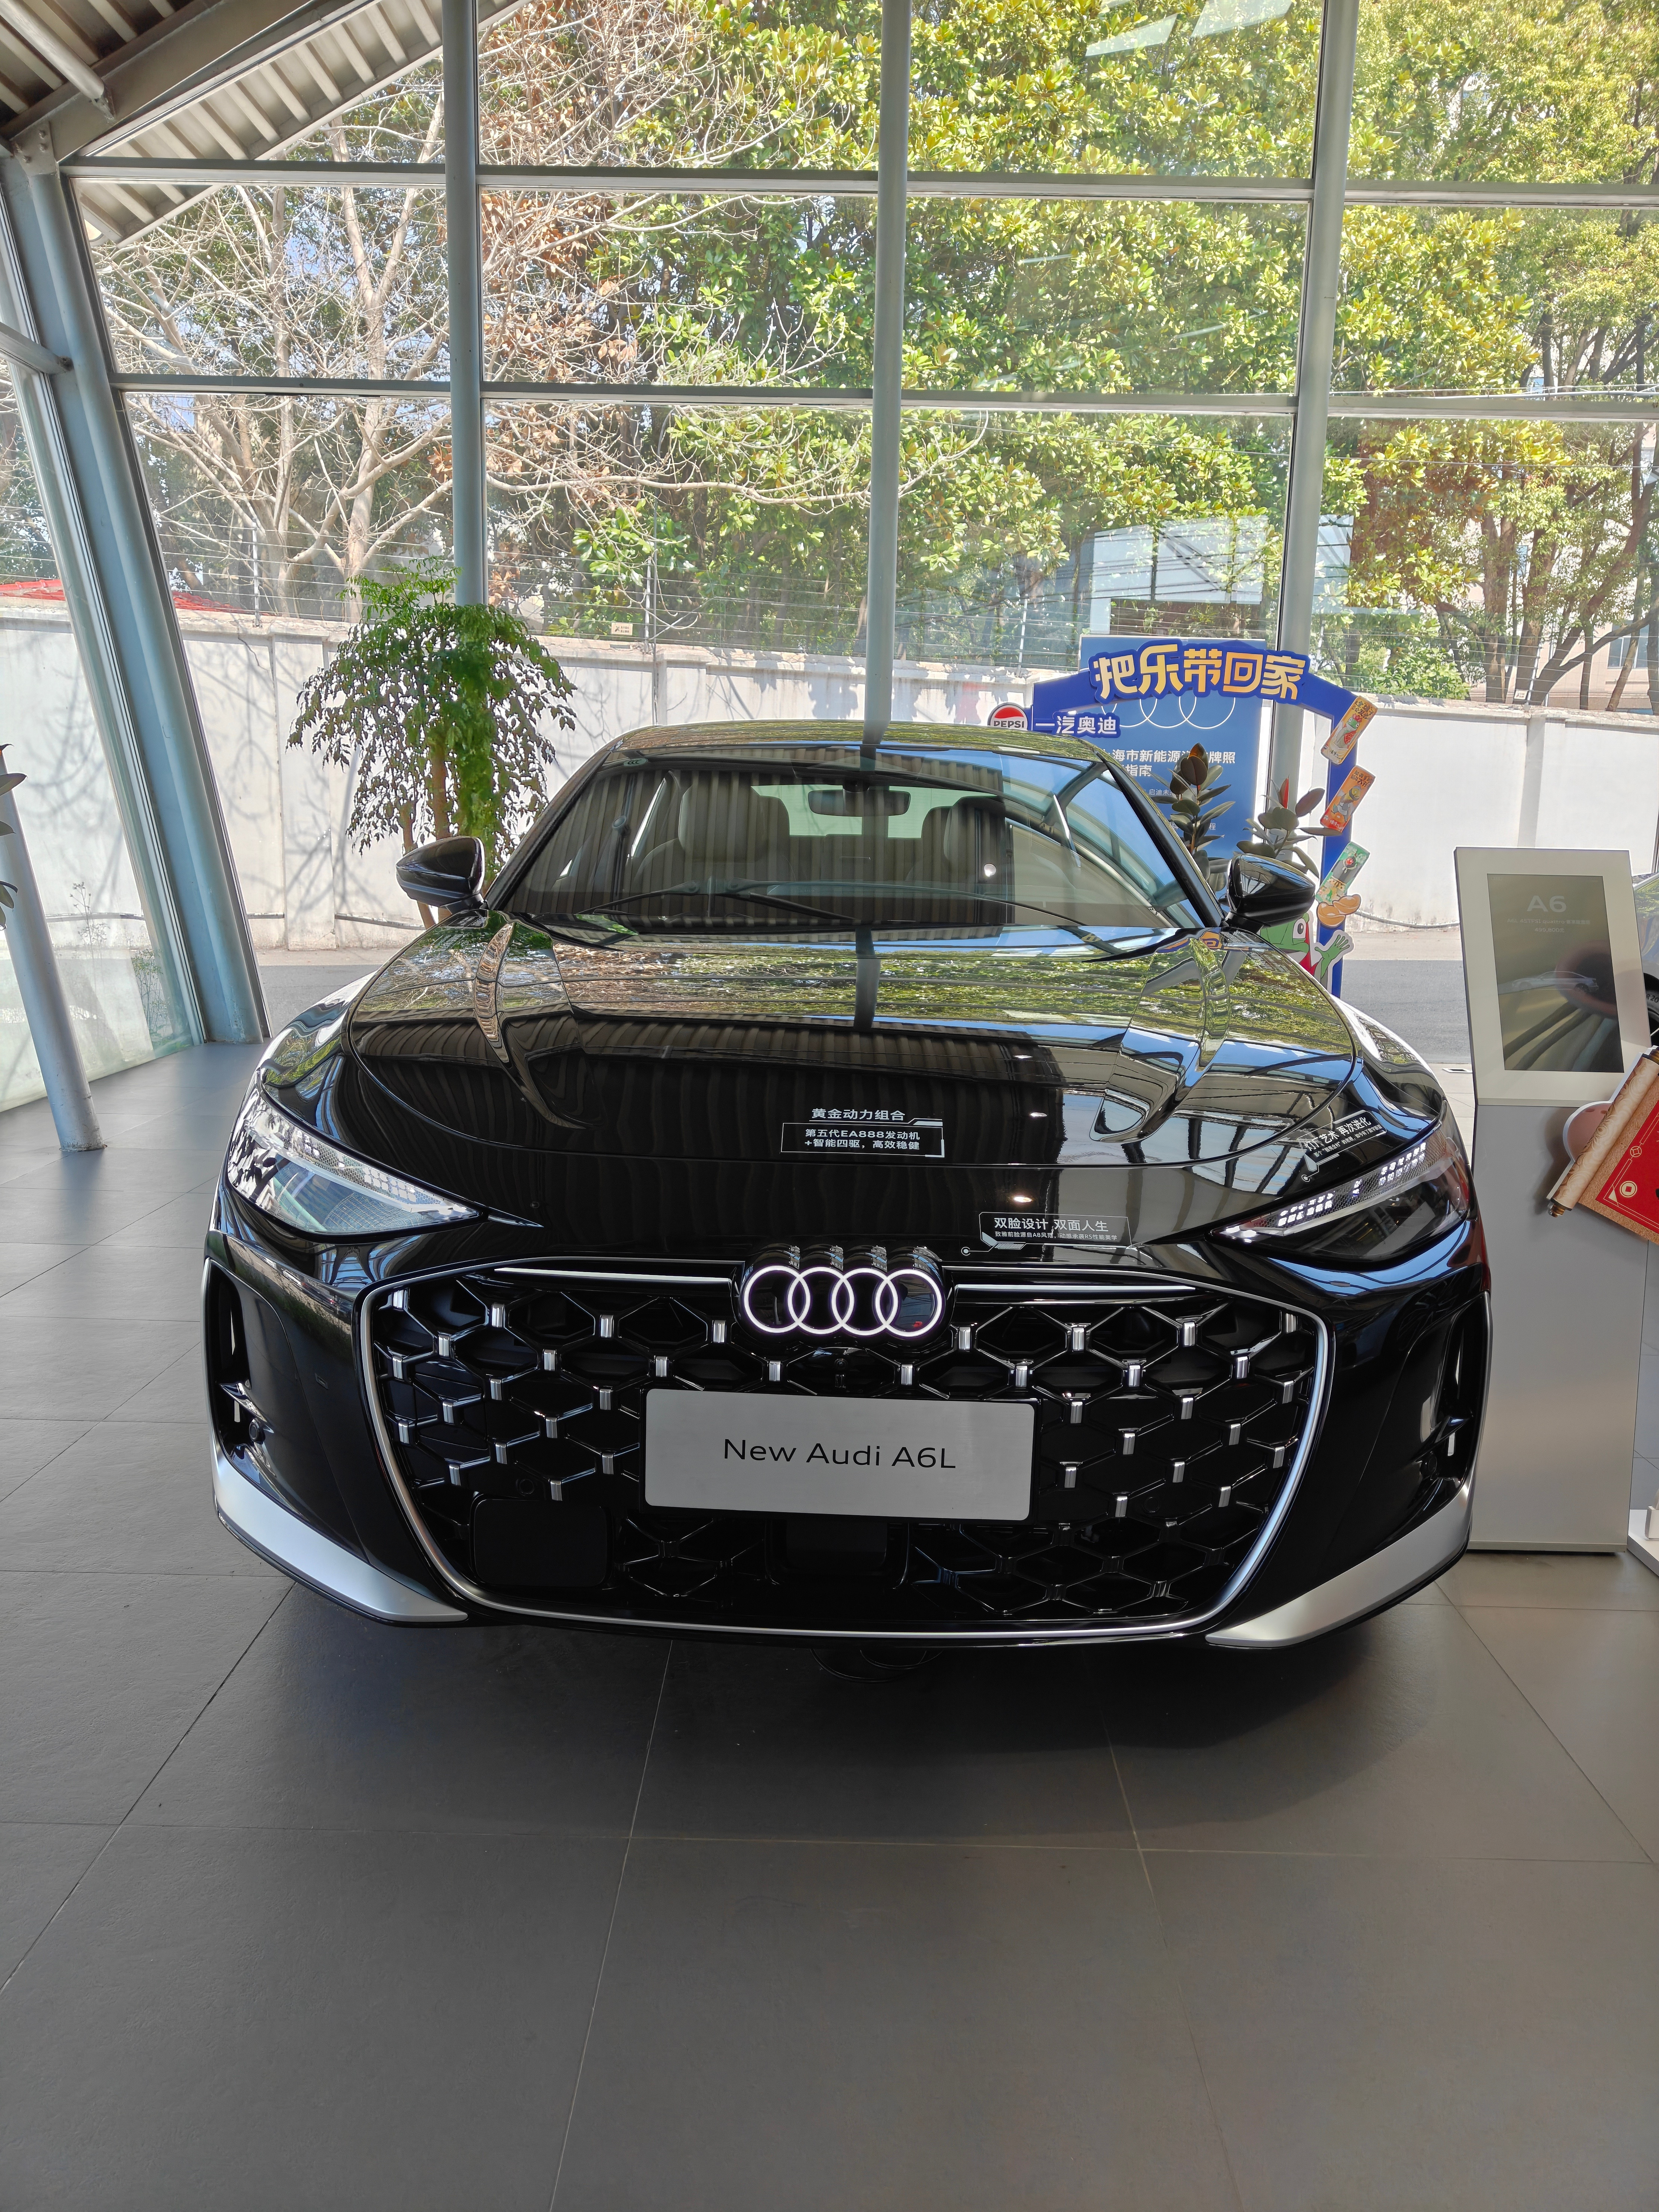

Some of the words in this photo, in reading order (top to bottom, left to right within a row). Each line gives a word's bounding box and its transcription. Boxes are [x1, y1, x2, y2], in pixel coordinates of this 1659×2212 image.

[1093, 644, 1305, 700] 把乐带回家
[1035, 715, 1117, 734] 一汽奥迪
[1103, 749, 1236, 764] 海市新能源牌照
[1123, 764, 1152, 777] 指南
[1527, 895, 1567, 912] A6
[811, 1108, 905, 1121] 黄金动力组合
[1336, 1116, 1372, 1136] 再次进化
[805, 1129, 920, 1140] 第五代EA888发动机
[994, 1218, 1049, 1230] 双脸设计
[1053, 1219, 1109, 1232] 双面人生
[724, 1439, 796, 1462] New
[806, 1443, 880, 1466] Audi
[891, 1446, 956, 1469] A6L
